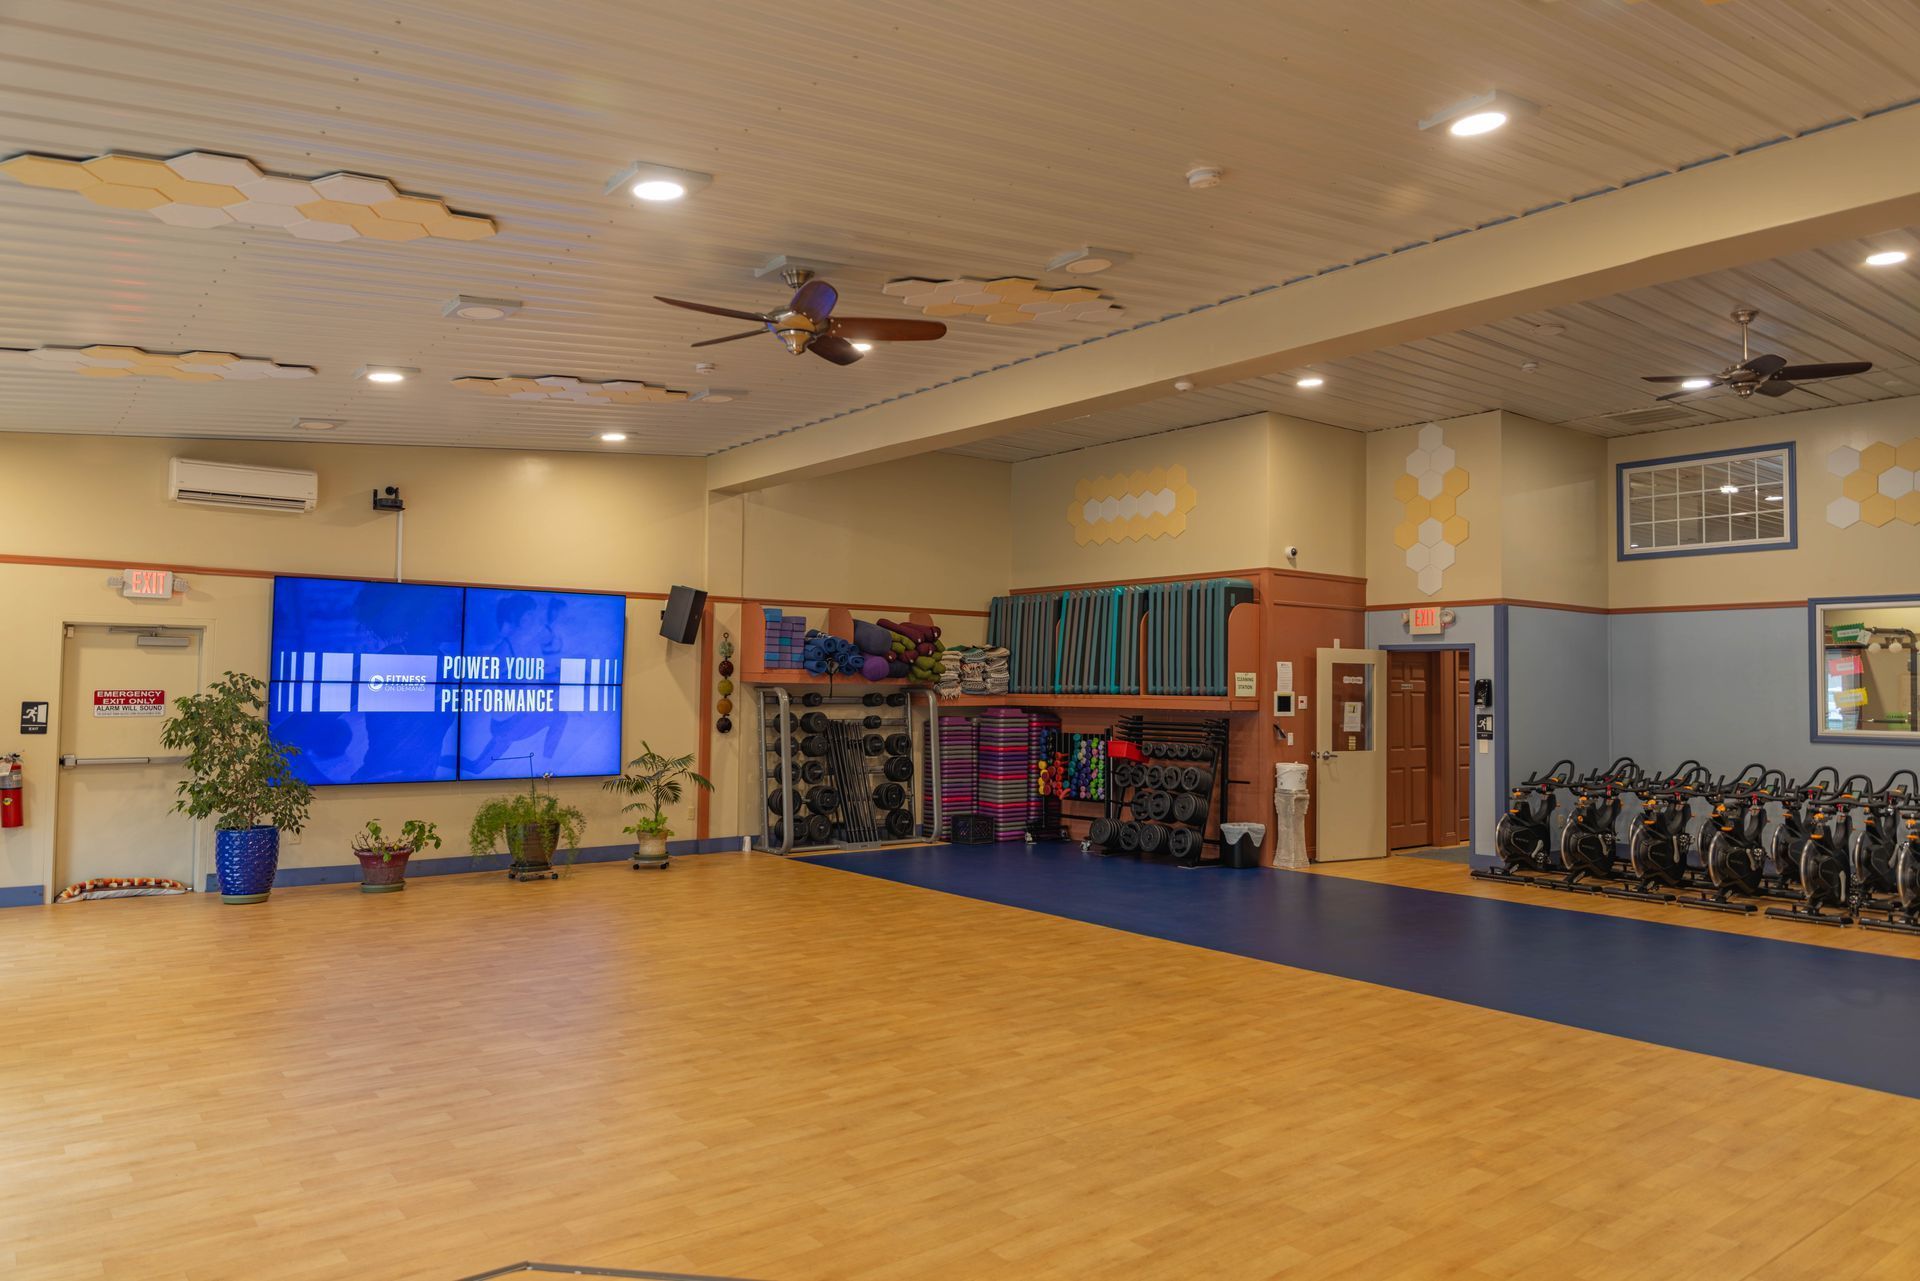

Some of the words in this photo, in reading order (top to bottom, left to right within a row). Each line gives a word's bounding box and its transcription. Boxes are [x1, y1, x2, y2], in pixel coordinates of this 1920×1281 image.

[132, 571, 167, 594] EXIT
[1415, 608, 1436, 627] EXIT
[443, 655, 500, 680] POWER
[505, 657, 545, 680] YOUR
[385, 675, 426, 686] FITNESS
[96, 690, 162, 698] EMERGENCY
[441, 689, 554, 713] PERFORMANCE
